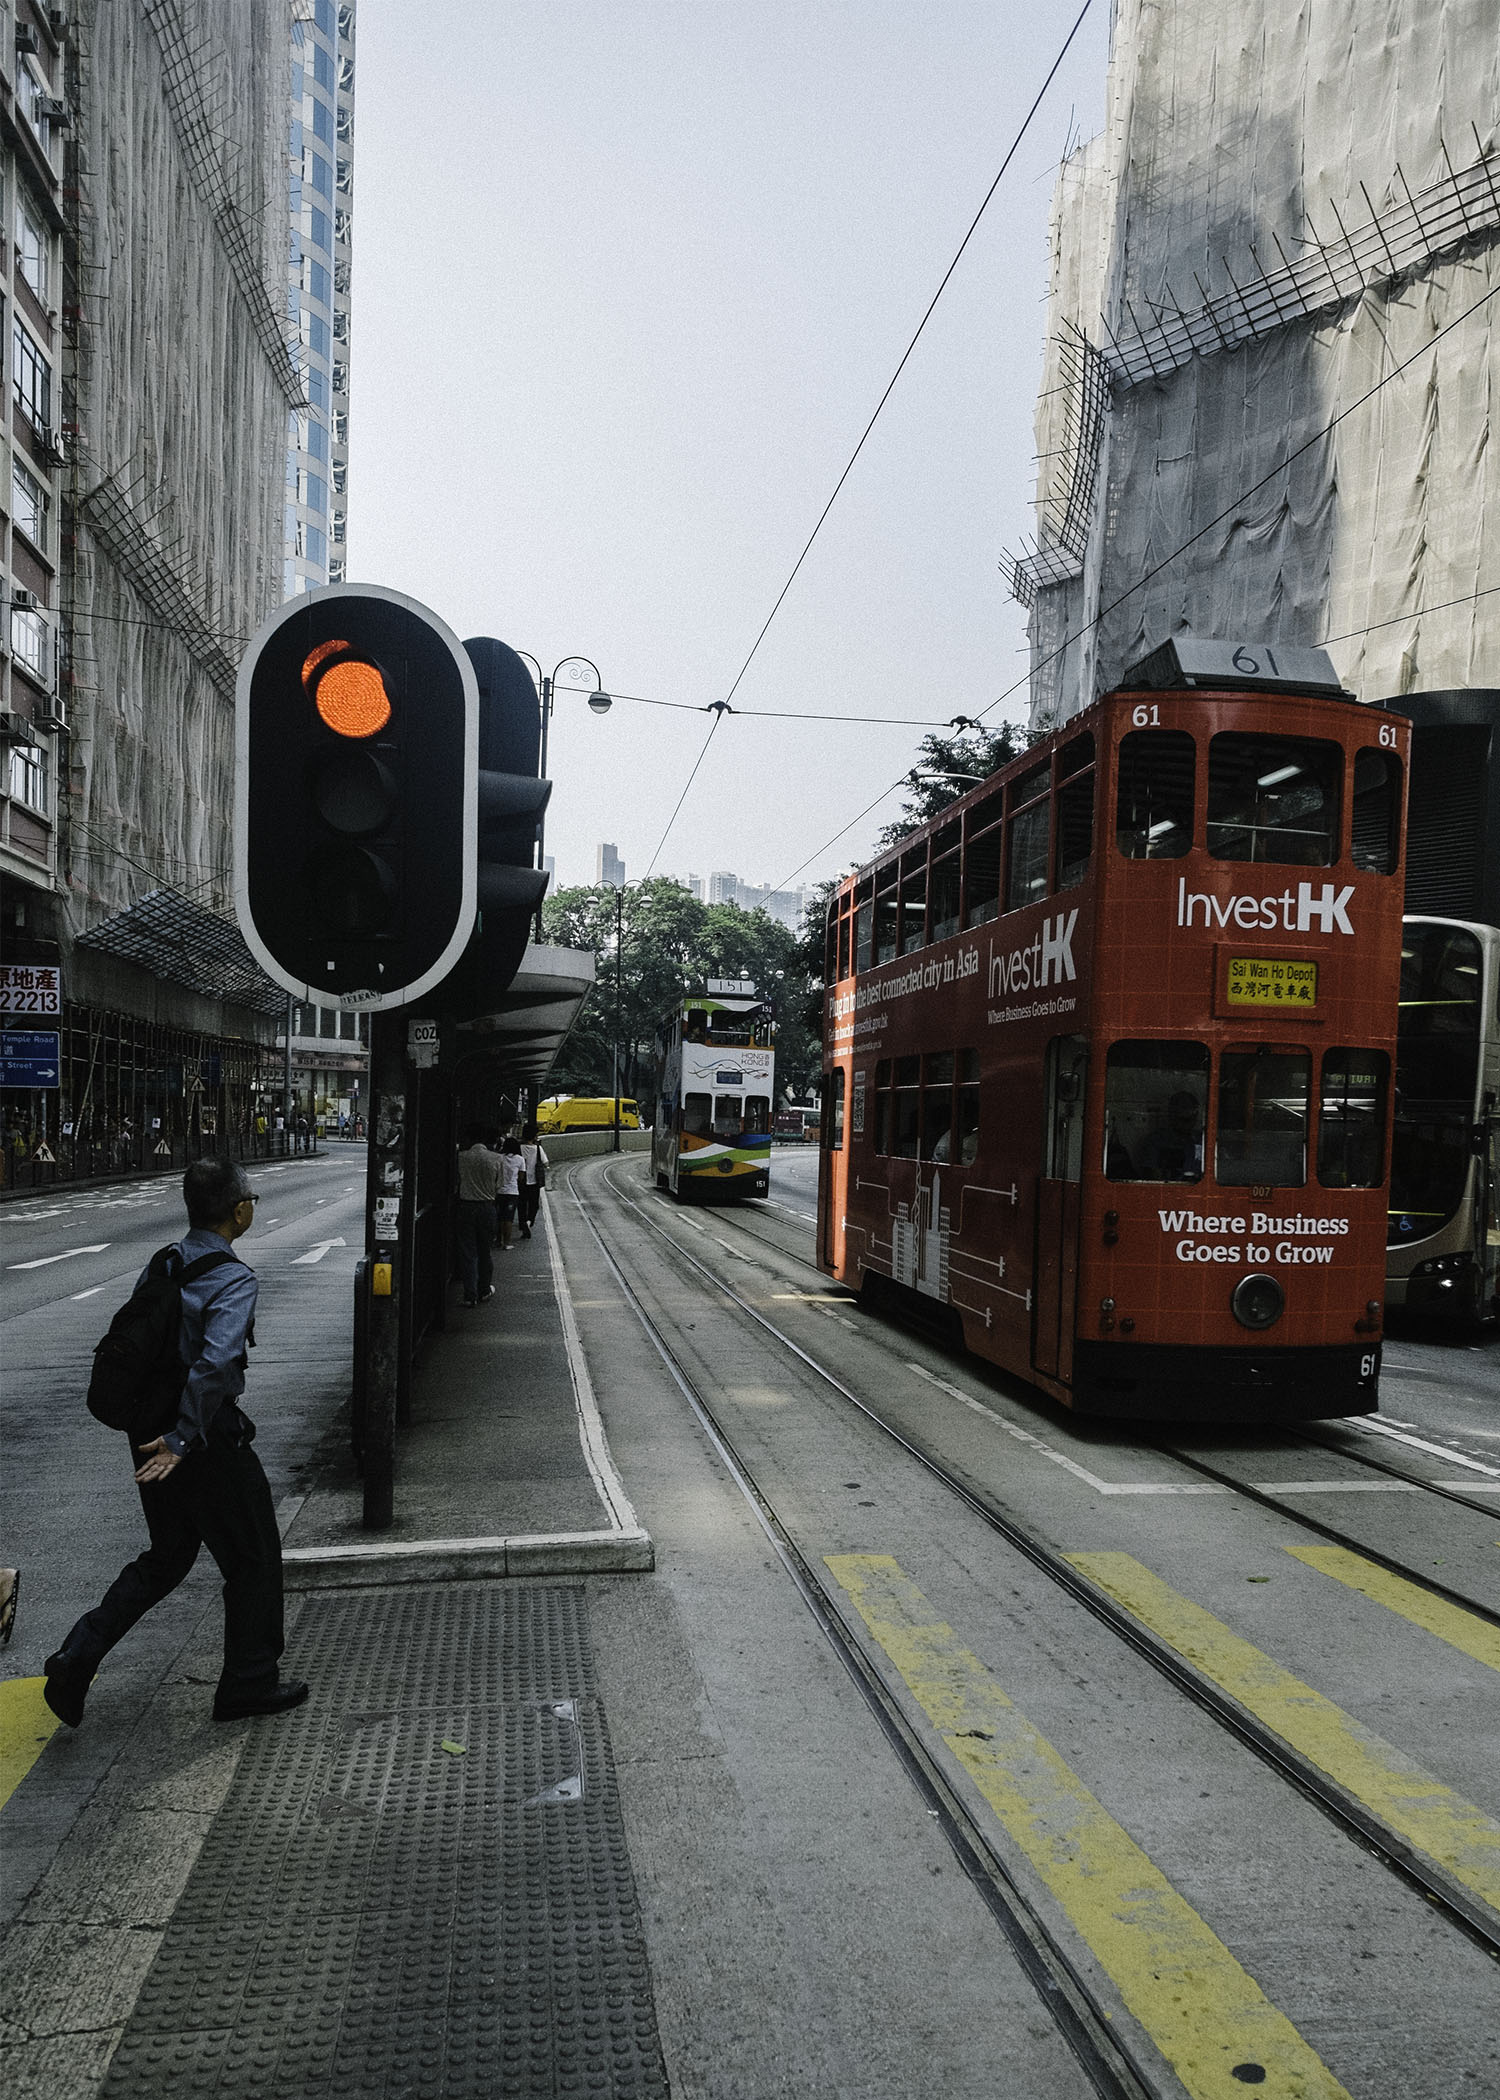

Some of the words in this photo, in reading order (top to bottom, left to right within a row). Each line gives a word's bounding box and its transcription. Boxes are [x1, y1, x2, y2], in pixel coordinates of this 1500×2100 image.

[1232, 646, 1280, 677] 61
[1132, 704, 1161, 728] 61
[1379, 724, 1397, 748] 61
[1177, 876, 1356, 935] InvestHK
[988, 908, 1079, 999] InvestHK
[856, 986, 866, 1009] the
[867, 981, 882, 1006] best
[882, 963, 923, 1001] connected
[924, 959, 942, 991] city
[943, 954, 954, 983] in
[956, 944, 979, 980] Asia
[1231, 961, 1247, 977] Sai
[1250, 962, 1268, 978] Wan
[1271, 964, 1284, 979] Ho
[1287, 965, 1314, 982] Depot
[719, 981, 743, 992] 151
[1231, 981, 1312, 1001] 西灣河電車廠
[690, 1001, 702, 1009] 151
[761, 1005, 772, 1013] 151
[988, 1009, 1005, 1024] Where
[1005, 1005, 1032, 1022] Business
[1032, 1001, 1049, 1017] Goes
[1050, 1000, 1056, 1014] to
[1057, 996, 1077, 1013] Grow
[1, 1034, 31, 1044] Temple
[33, 1035, 55, 1043] Road
[7, 1061, 33, 1069] Street
[741, 1052, 764, 1060] HONG
[756, 1180, 766, 1188] 151
[1252, 1185, 1271, 1197] 007
[1158, 1210, 1246, 1234] Where
[1251, 1212, 1349, 1235] Business
[1176, 1240, 1241, 1263] Goes
[1246, 1242, 1271, 1264] to
[1275, 1242, 1334, 1264] Grow
[1361, 1353, 1376, 1377] 61
